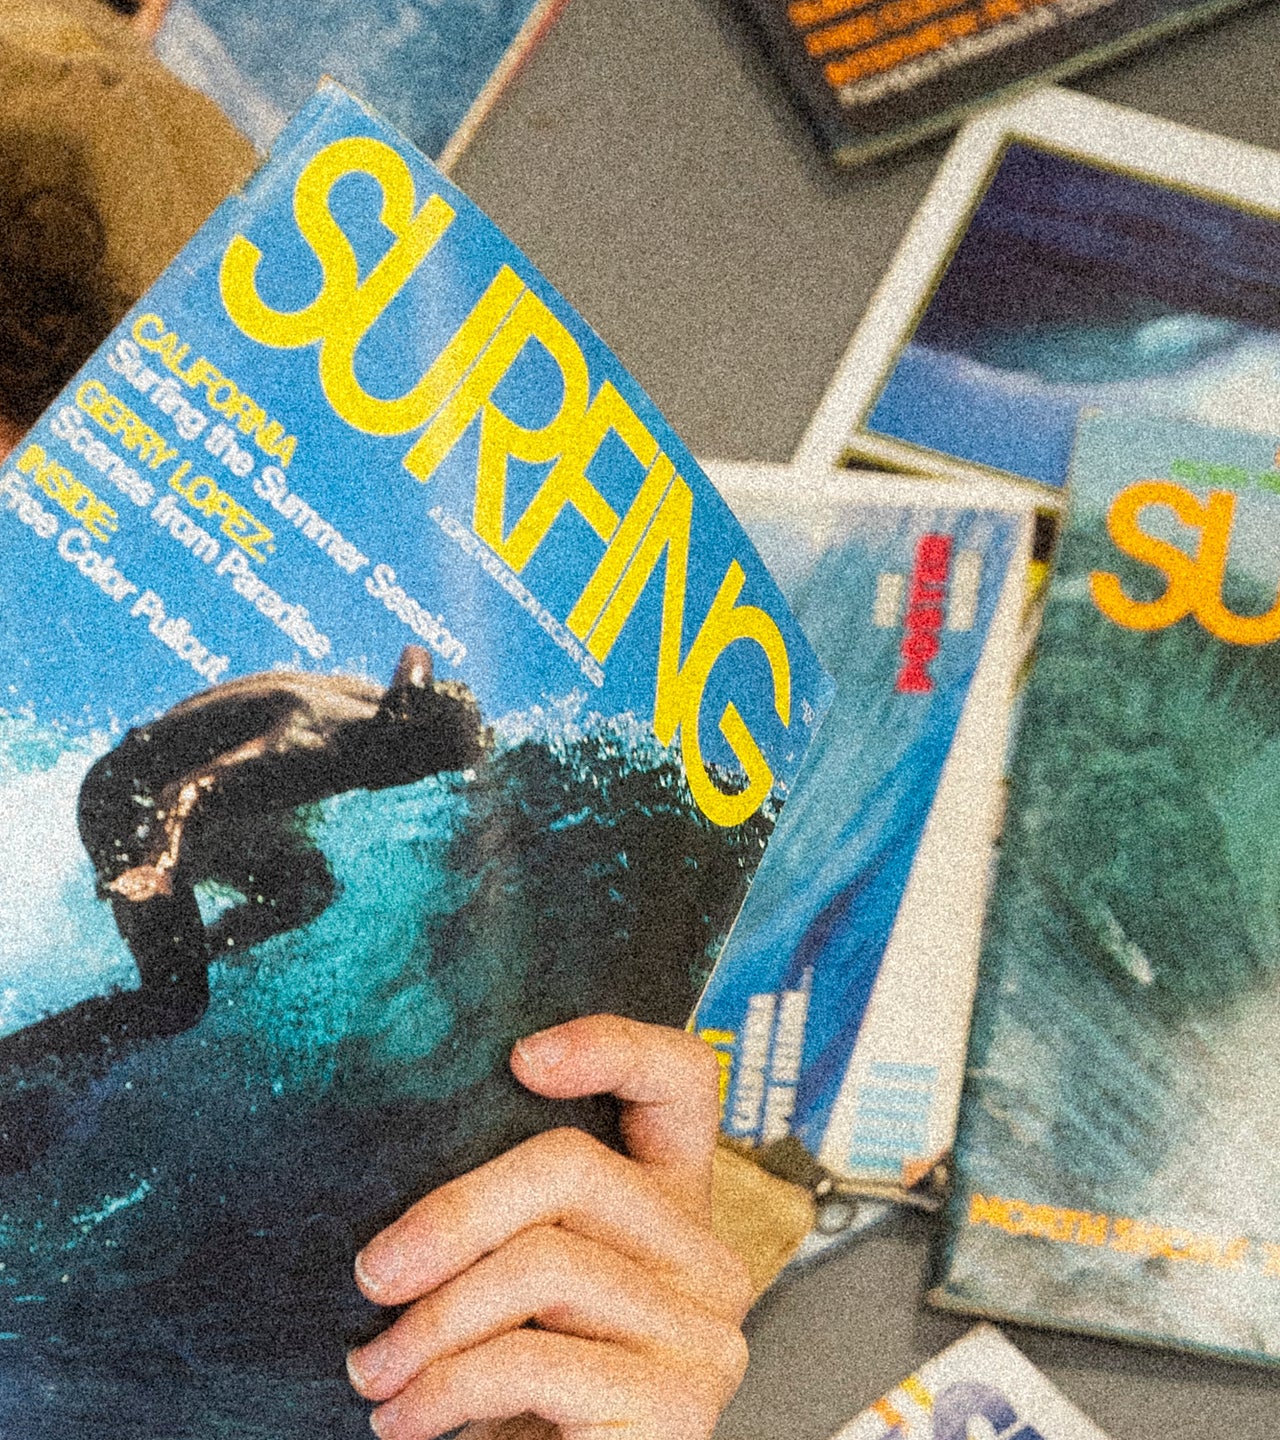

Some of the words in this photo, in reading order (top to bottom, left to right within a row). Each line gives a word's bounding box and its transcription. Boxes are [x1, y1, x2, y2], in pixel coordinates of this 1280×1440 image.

[71, 377, 179, 471] GERRY
[167, 460, 276, 564] LOPEZ:
[129, 311, 298, 469] CALIFORNIA
[13, 442, 119, 544] INSIDE:
[48, 403, 156, 507] Scenes
[150, 493, 221, 564] from
[215, 548, 332, 661] Paradise
[104, 337, 210, 441] Surfing
[204, 422, 255, 477] the
[252, 465, 370, 574] Summer
[364, 563, 470, 669] Session
[218, 136, 792, 827] SURFING
[57, 527, 138, 602] Color
[129, 589, 230, 686] Pullout
[892, 531, 959, 698] POSTER
[966, 1192, 1111, 1247] NORTH
